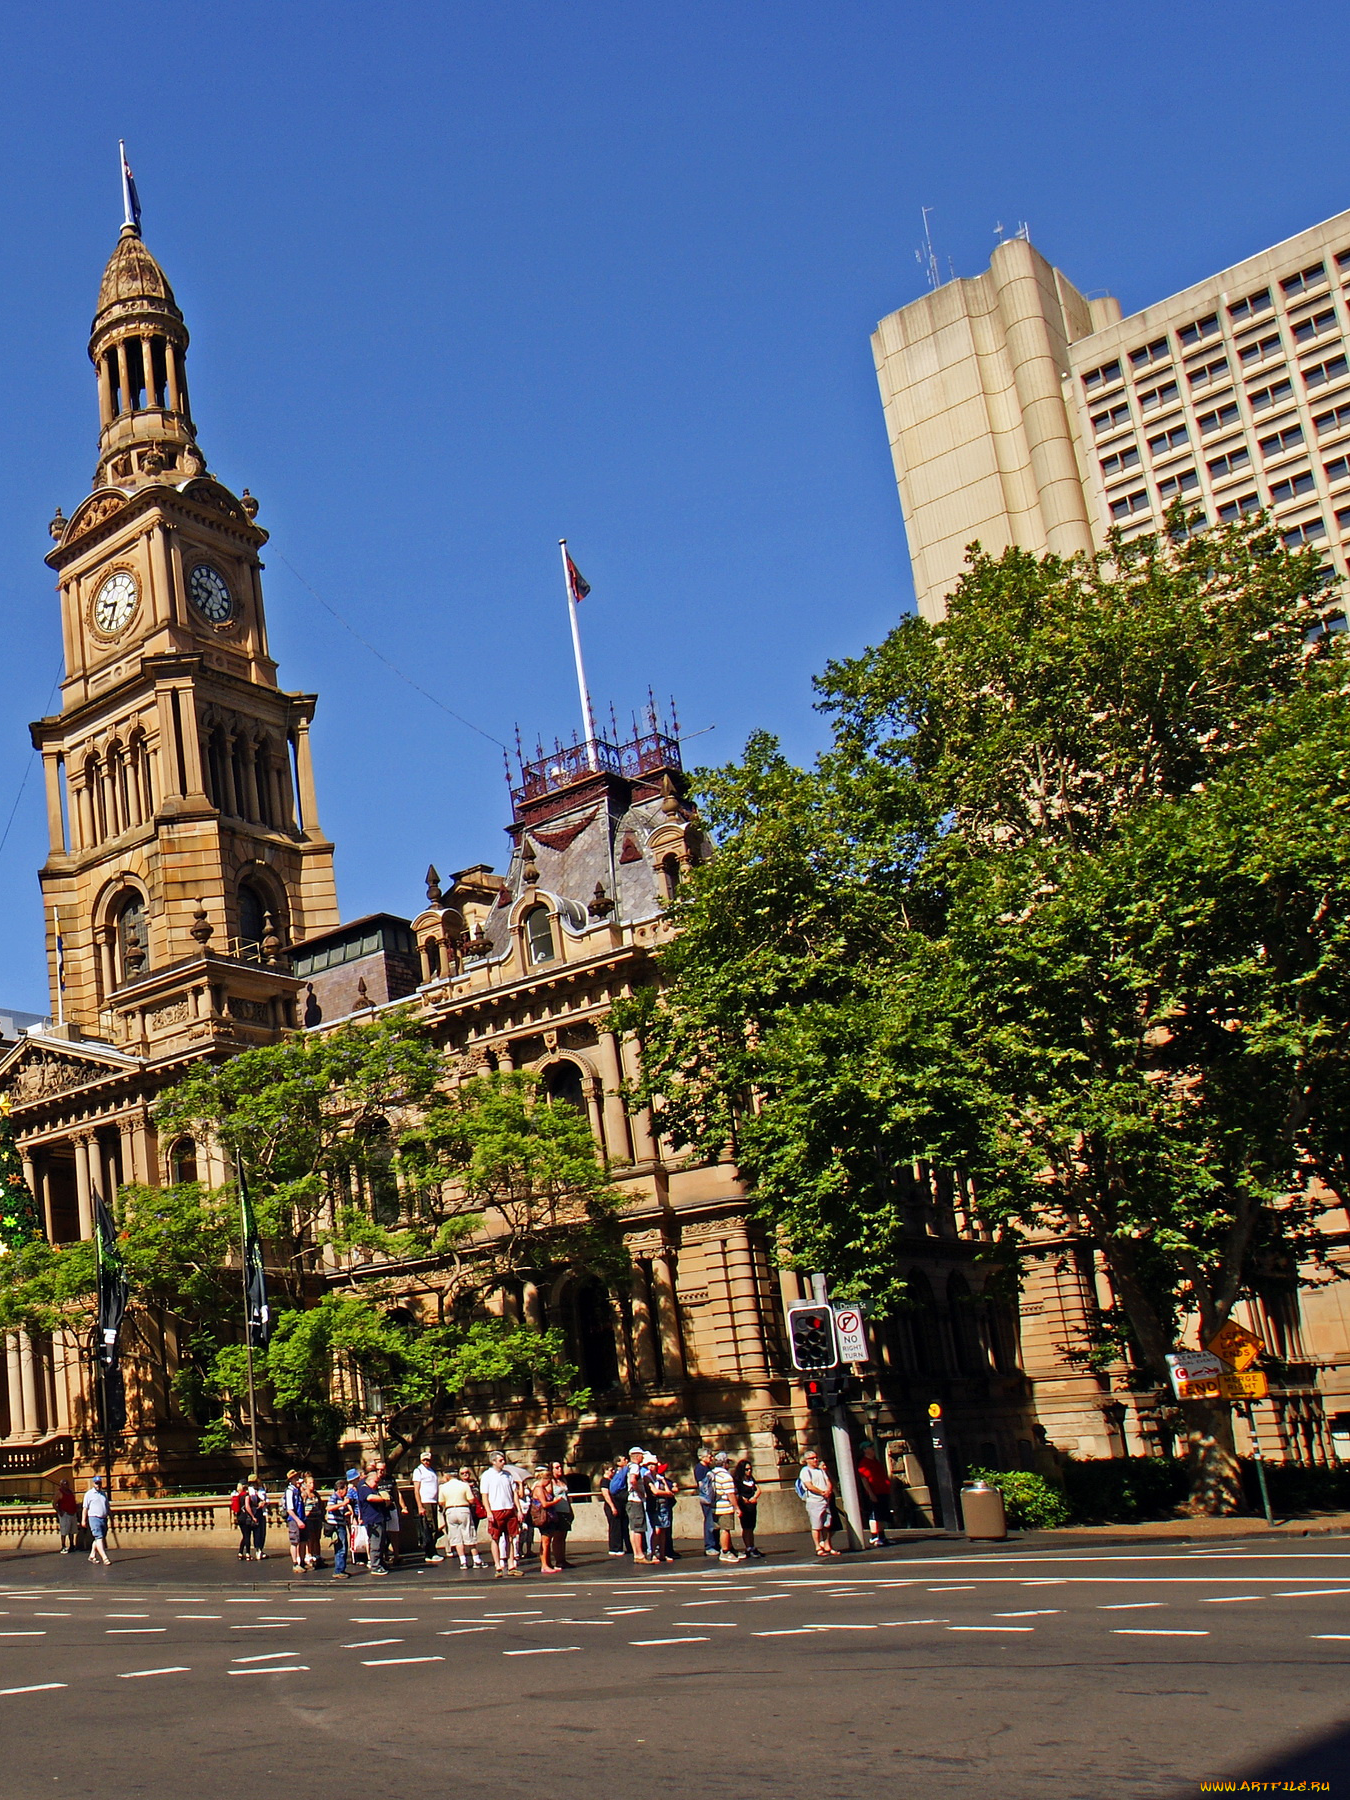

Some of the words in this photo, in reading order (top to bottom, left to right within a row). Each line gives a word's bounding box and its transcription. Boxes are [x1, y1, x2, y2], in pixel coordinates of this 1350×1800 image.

[843, 1335, 857, 1343] NO
[1220, 1331, 1244, 1340] LEFT
[1220, 1339, 1248, 1349] LANE
[1223, 1349, 1250, 1358] ENDS
[1186, 1381, 1217, 1395] END
